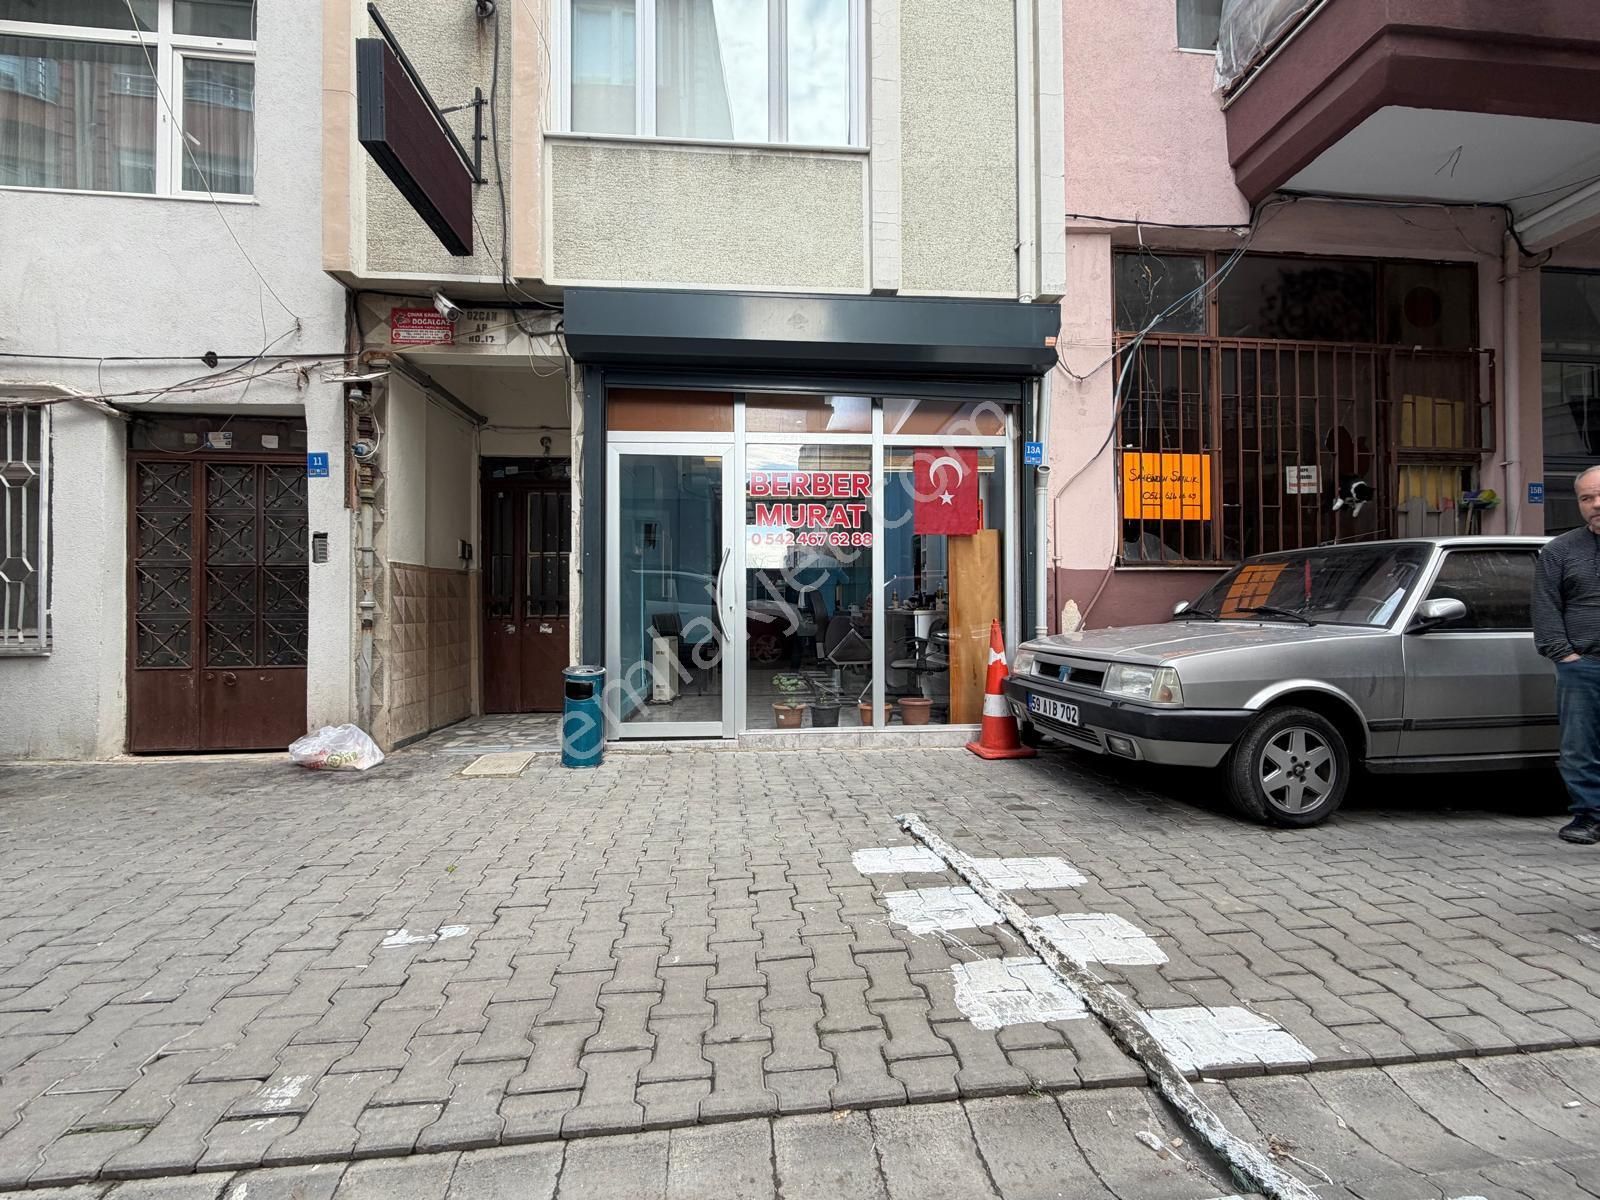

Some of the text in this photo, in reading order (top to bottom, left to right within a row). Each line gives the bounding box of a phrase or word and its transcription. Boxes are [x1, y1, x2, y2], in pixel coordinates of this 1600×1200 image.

[1026, 445, 1041, 455] 13A
[313, 456, 323, 466] 11
[750, 472, 872, 497] BERBER
[755, 504, 867, 529] MURAT
[751, 532, 872, 547] 0 542 467 62 88
[1031, 695, 1078, 723] 59 AIB 702
